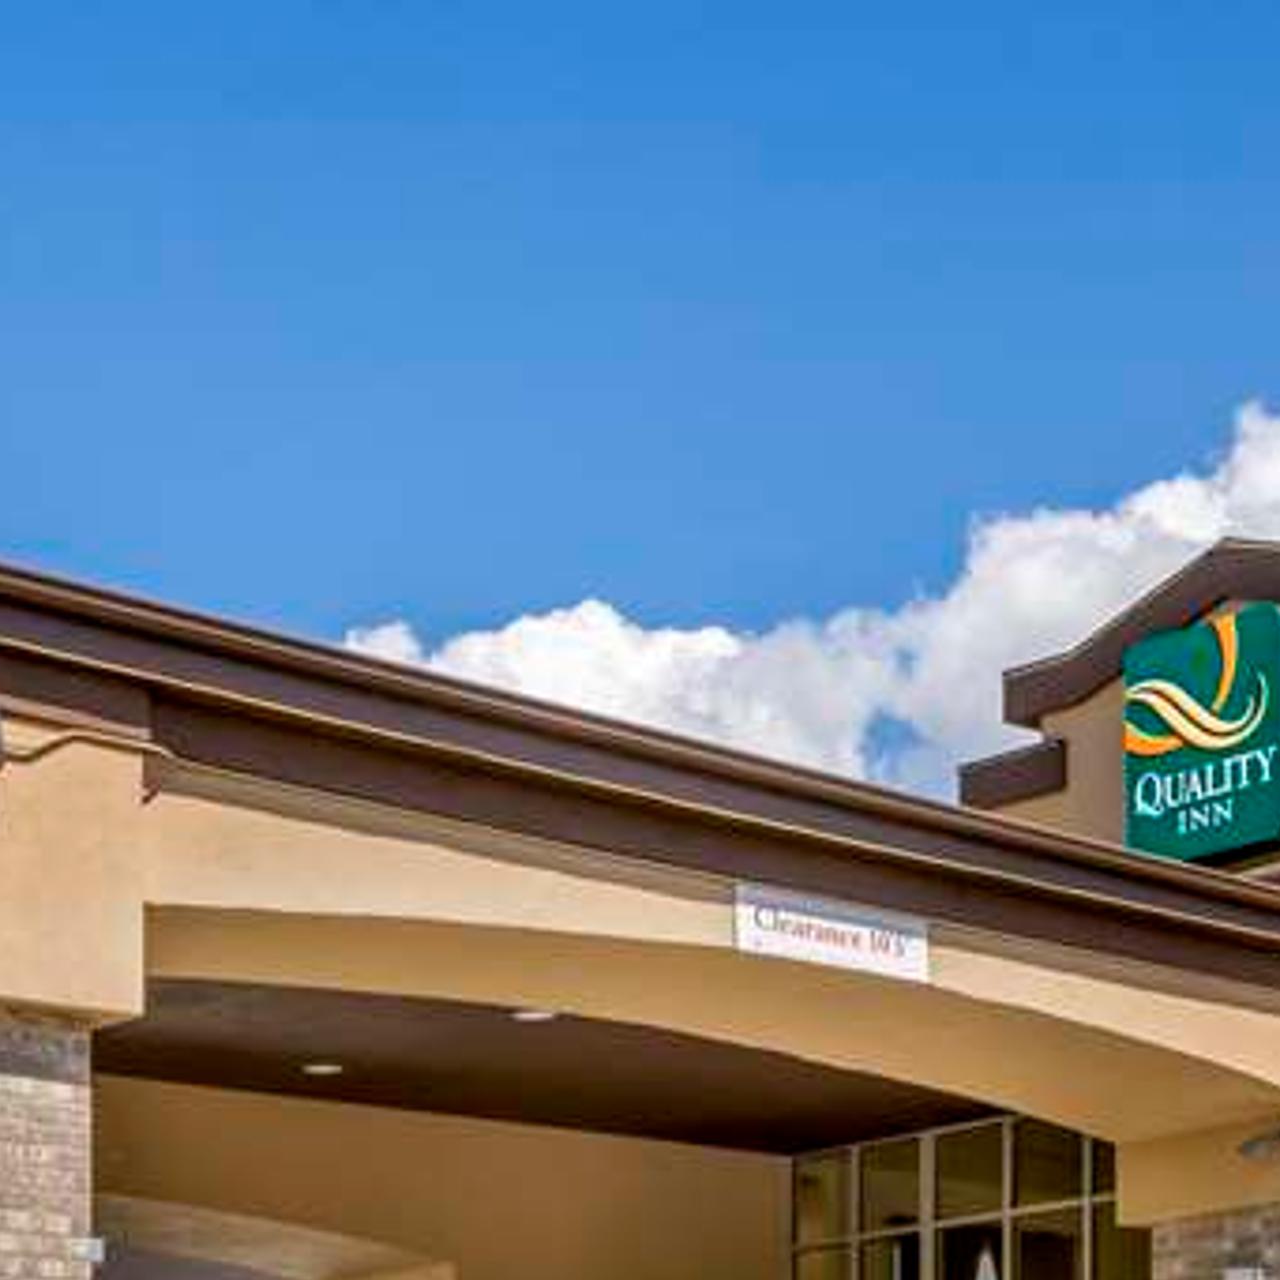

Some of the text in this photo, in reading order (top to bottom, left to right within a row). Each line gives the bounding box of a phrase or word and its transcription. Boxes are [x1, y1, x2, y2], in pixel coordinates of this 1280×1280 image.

[1135, 746, 1276, 817] QUALITY
[1177, 799, 1233, 834] INN
[753, 903, 861, 949] Clearance
